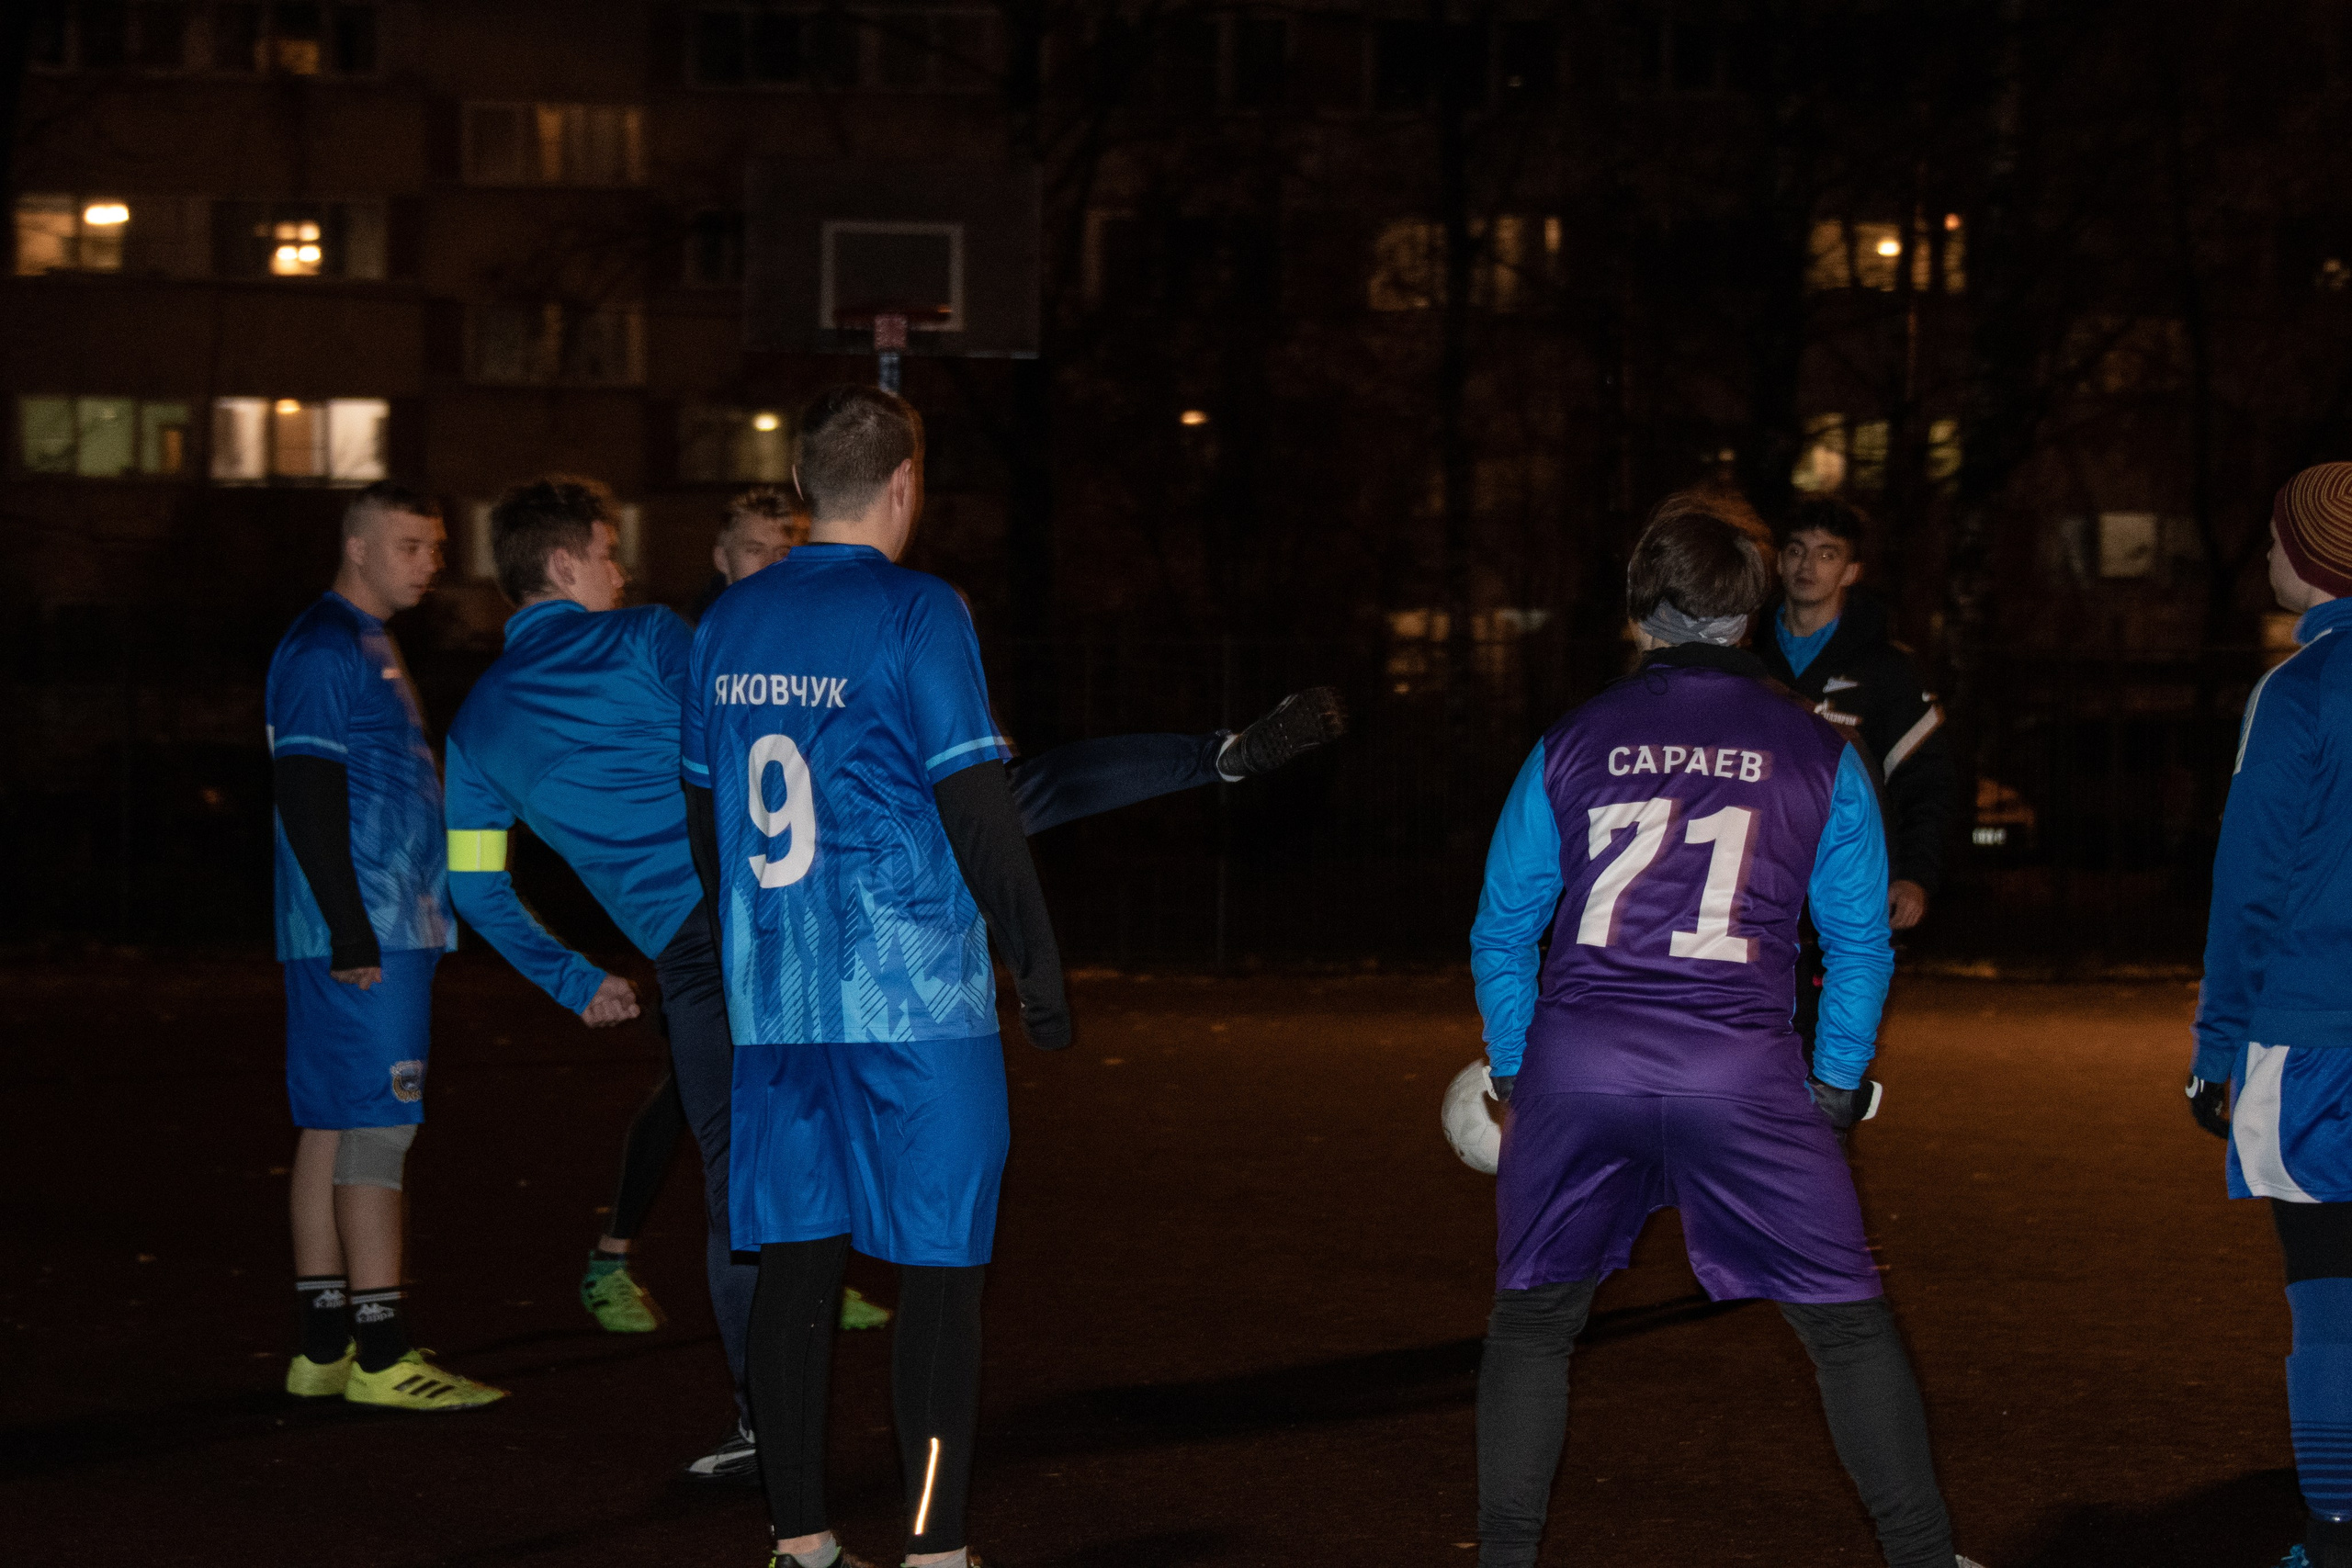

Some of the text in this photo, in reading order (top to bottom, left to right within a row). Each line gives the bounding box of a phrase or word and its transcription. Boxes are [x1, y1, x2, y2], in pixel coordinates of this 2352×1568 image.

[715, 673, 848, 708] ЯКОВЧУК
[748, 734, 816, 889] 9
[1608, 745, 1763, 783] САРАЕВ
[1576, 797, 1752, 964] 71
